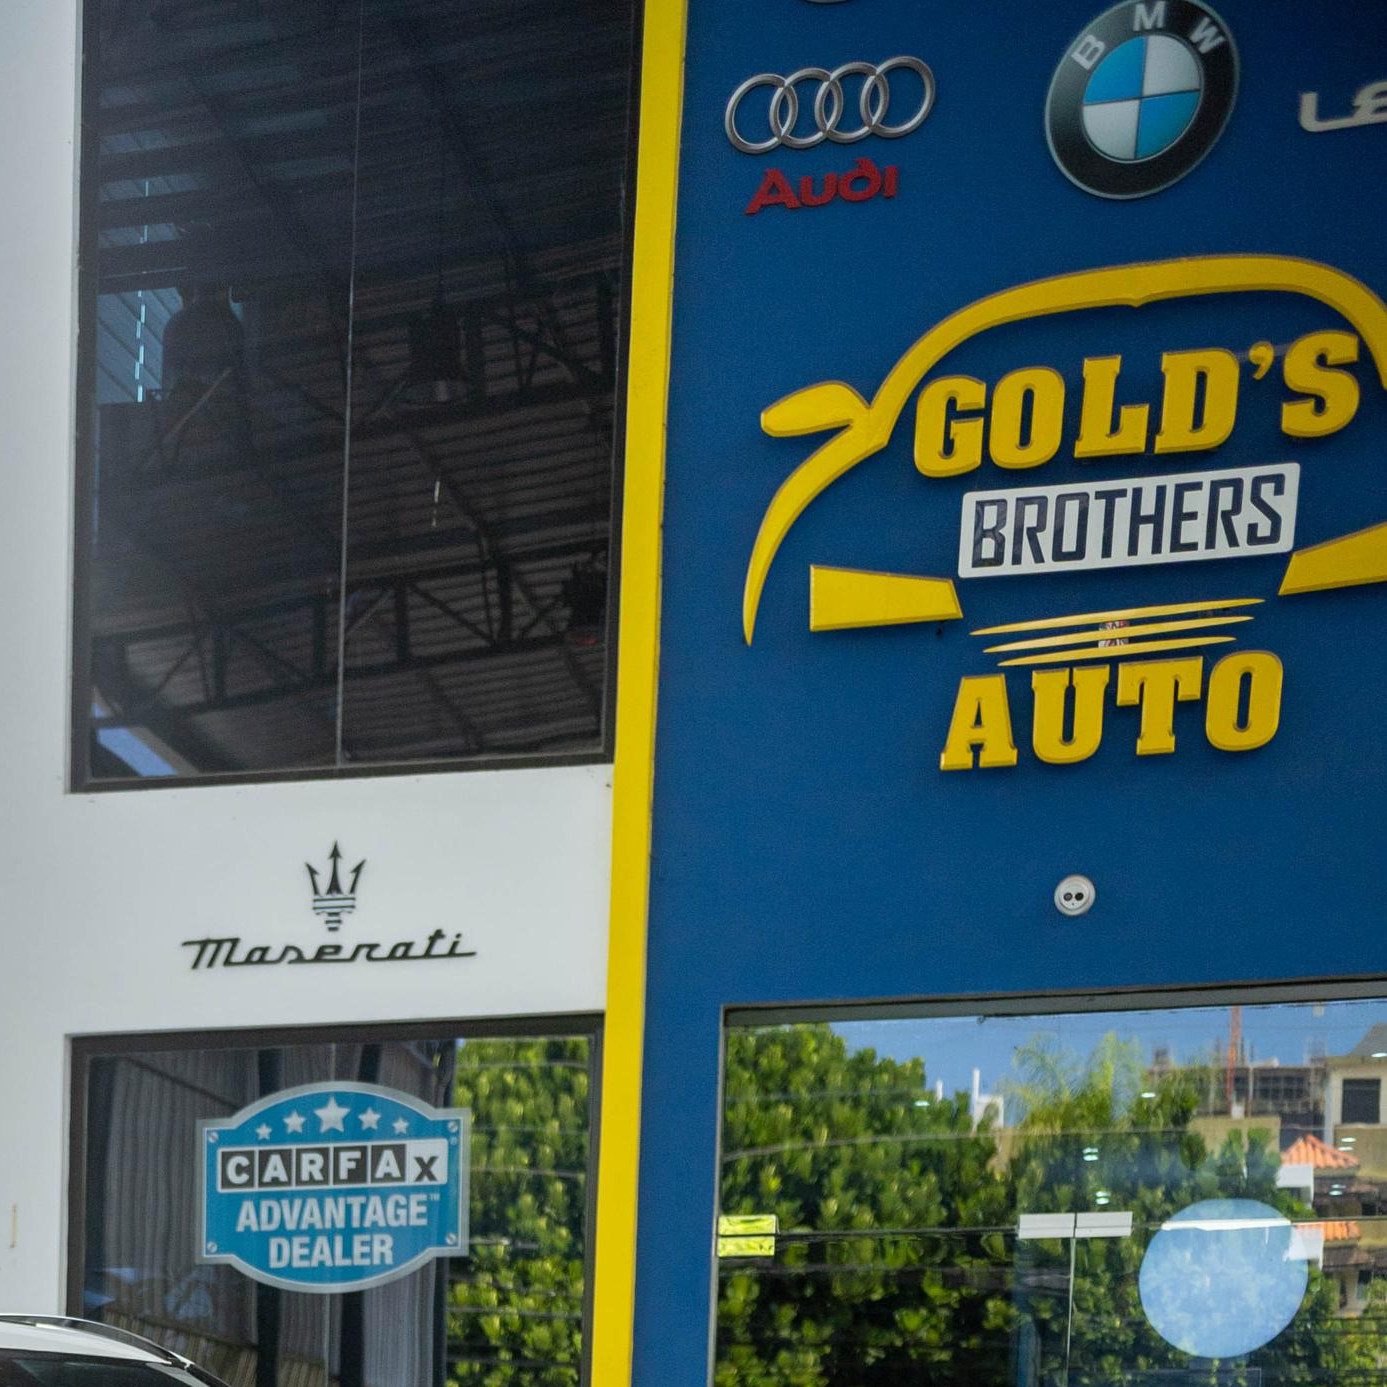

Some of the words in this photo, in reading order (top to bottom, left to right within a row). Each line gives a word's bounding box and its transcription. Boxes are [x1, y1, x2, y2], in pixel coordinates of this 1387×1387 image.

[1071, 1, 1226, 70] BMW
[744, 158, 900, 216] Audi
[913, 329, 1360, 478] GOLD'S
[972, 471, 1287, 570] BROTHERS
[940, 650, 1284, 771] AUTO
[181, 929, 477, 970] Maserati
[224, 1147, 439, 1185] CARFAX
[236, 1193, 428, 1233] ADVANTAGE
[269, 1235, 394, 1269] DEALER
